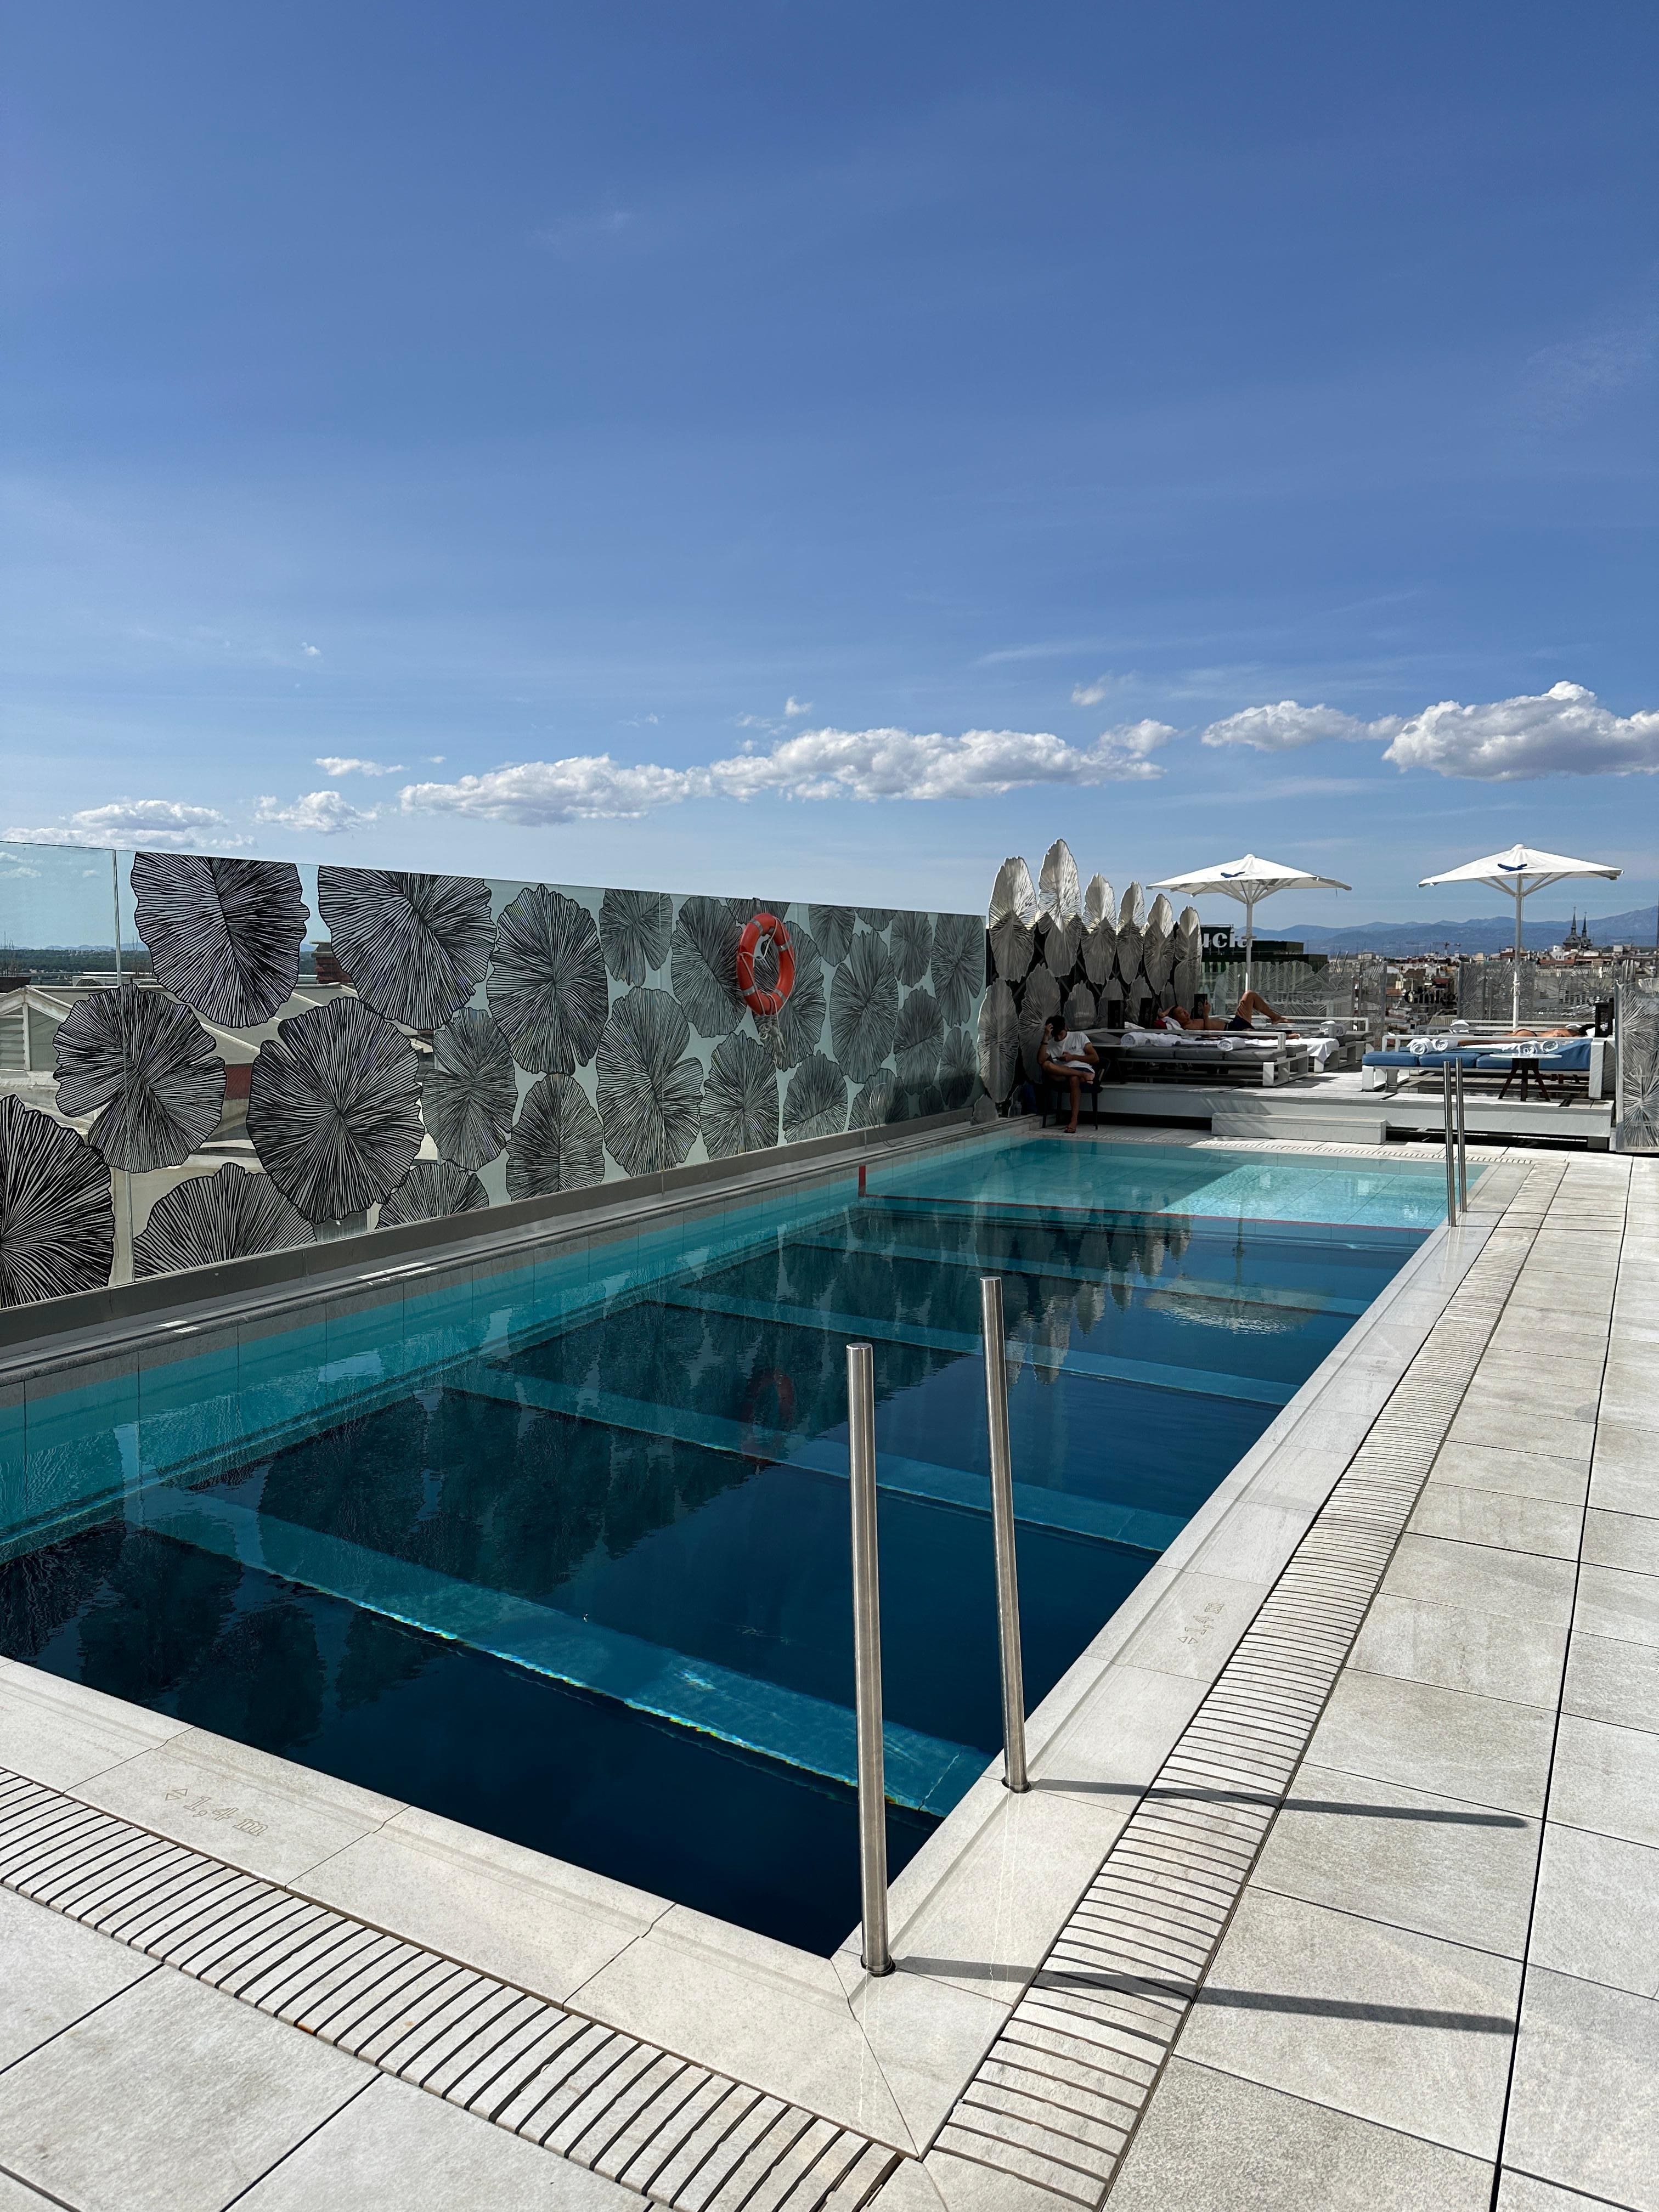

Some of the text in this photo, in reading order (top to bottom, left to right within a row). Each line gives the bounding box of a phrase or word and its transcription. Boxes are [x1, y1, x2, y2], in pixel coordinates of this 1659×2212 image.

[1404, 987, 1458, 1005] Ginkg
[1184, 1602, 1224, 1635] 1,4 m
[183, 1796, 269, 1837] 1,4 m
